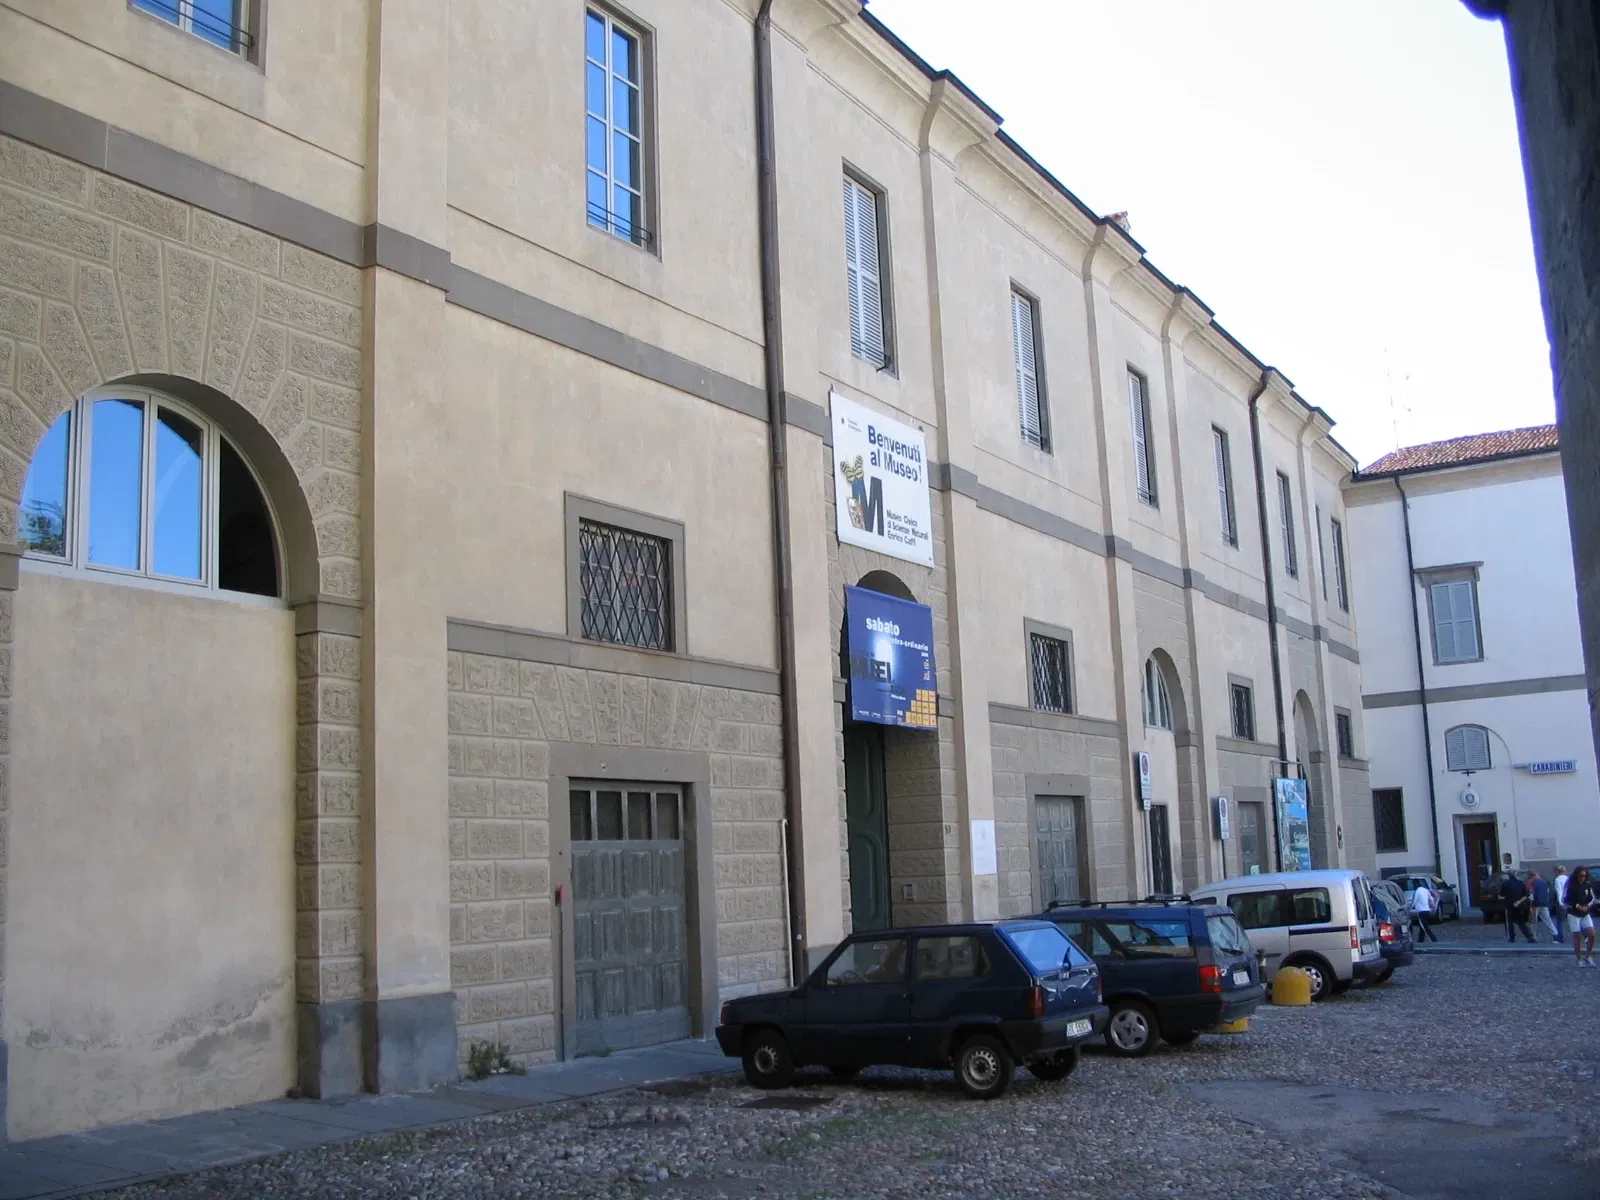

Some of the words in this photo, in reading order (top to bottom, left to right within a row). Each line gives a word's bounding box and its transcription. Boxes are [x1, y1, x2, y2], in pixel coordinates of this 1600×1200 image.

[867, 424, 921, 463] Benvenuti
[870, 448, 881, 468] al
[886, 509, 902, 522] Museo
[865, 617, 901, 637] sabato
[887, 637, 929, 652] xtra-ordinario
[1532, 761, 1573, 773] CARABINIERI
